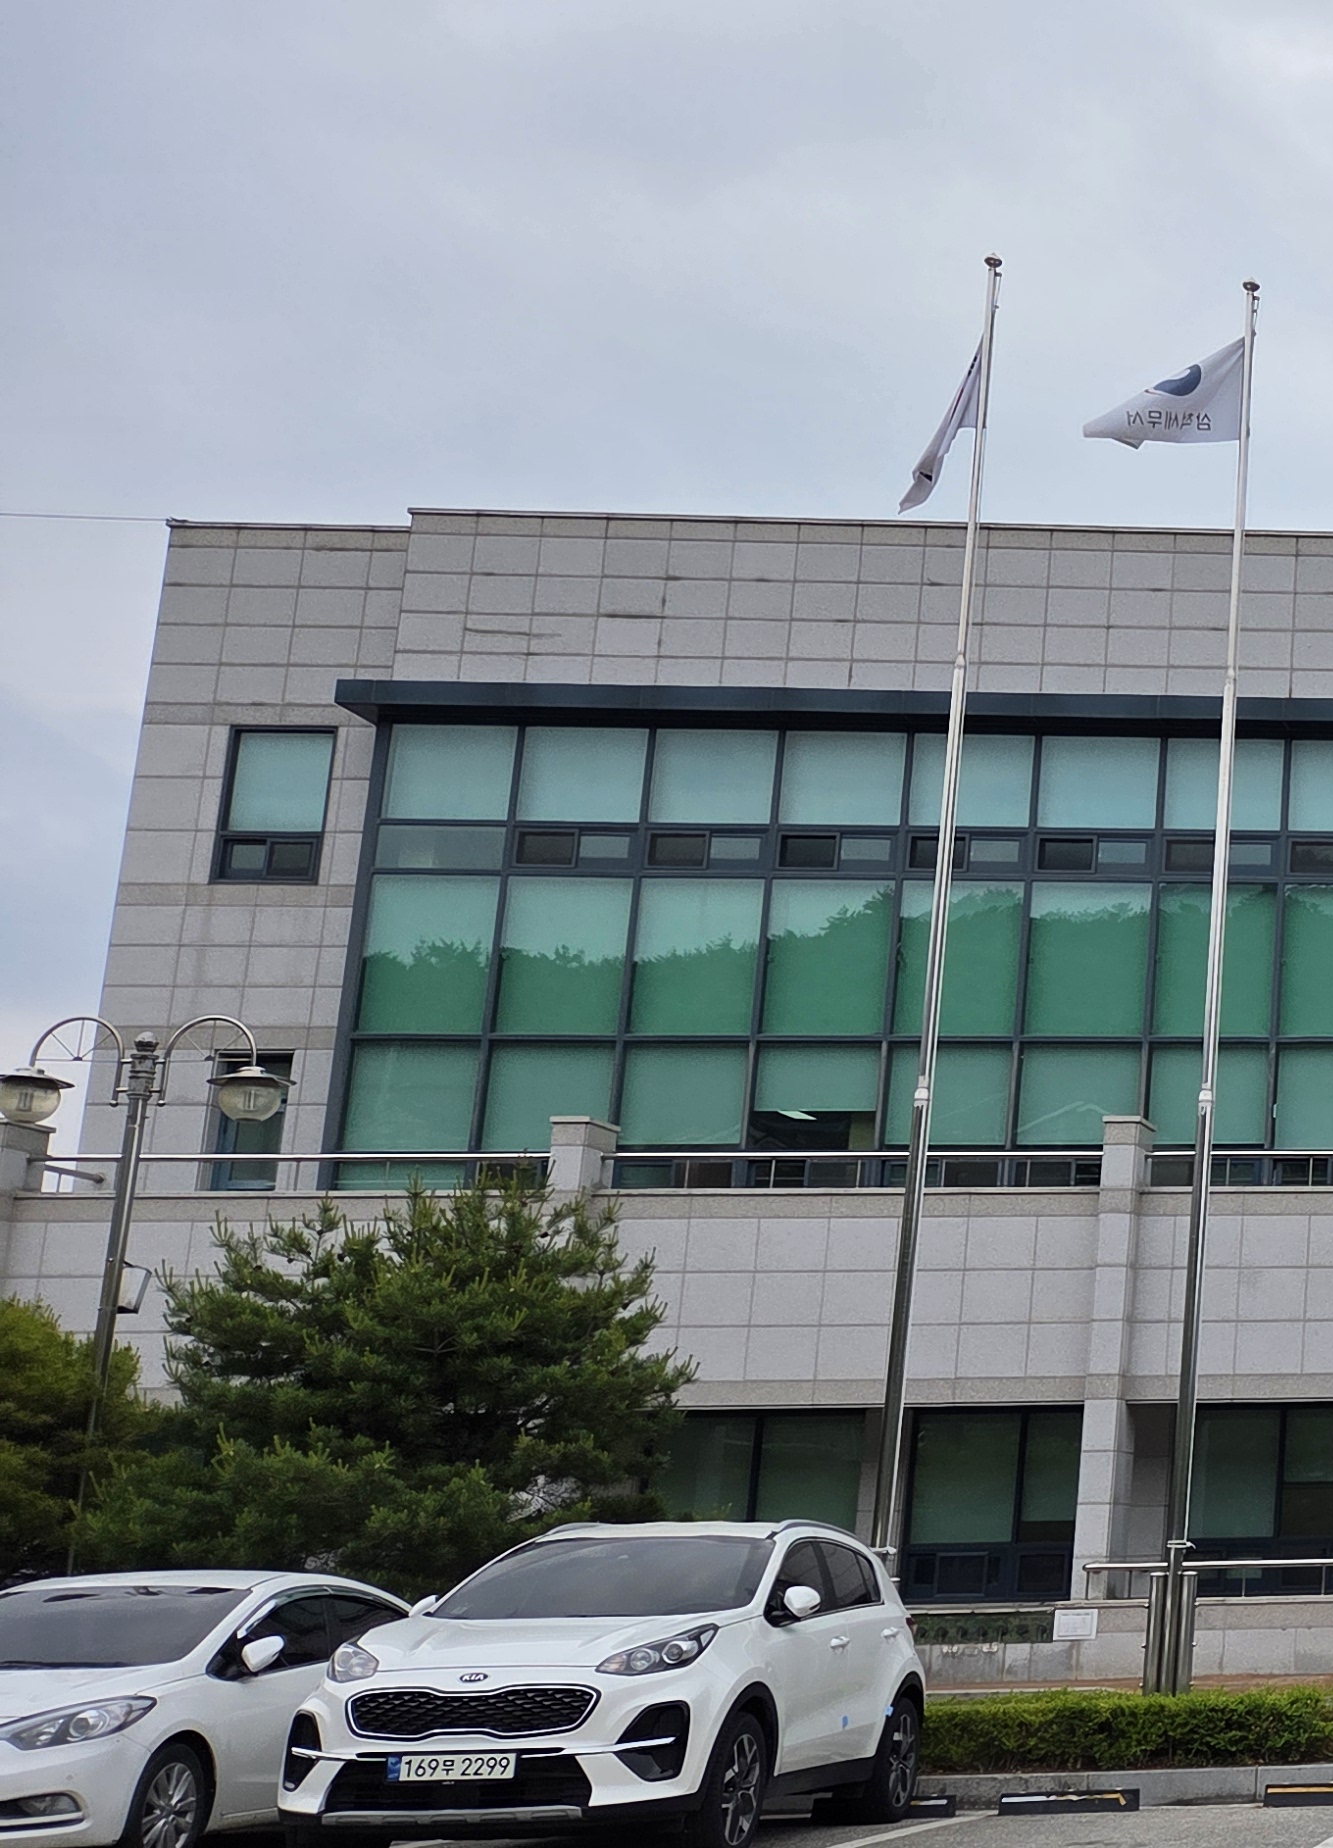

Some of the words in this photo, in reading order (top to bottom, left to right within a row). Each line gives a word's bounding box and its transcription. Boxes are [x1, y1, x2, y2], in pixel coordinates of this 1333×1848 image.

[461, 1673, 486, 1682] KIA
[404, 1758, 456, 1778] 169무
[459, 1756, 511, 1777] 2299
